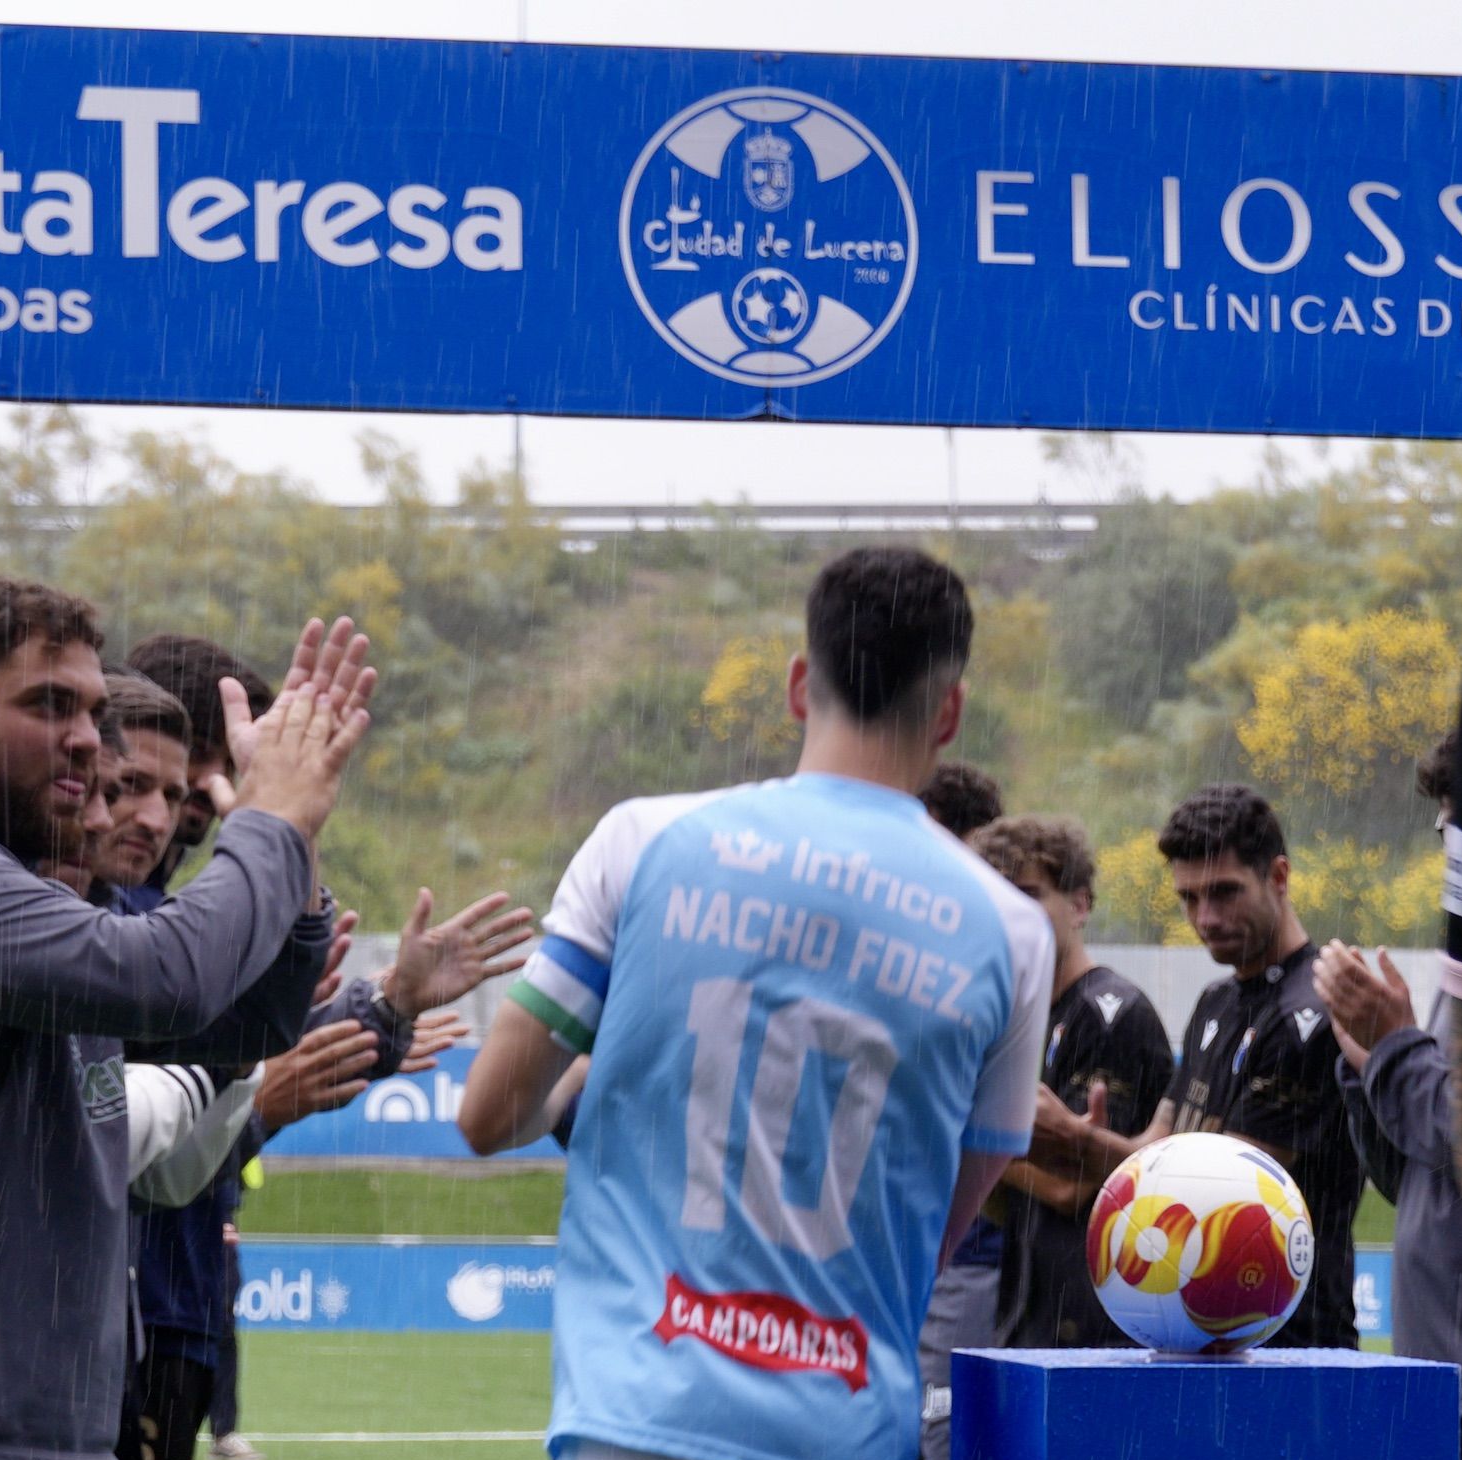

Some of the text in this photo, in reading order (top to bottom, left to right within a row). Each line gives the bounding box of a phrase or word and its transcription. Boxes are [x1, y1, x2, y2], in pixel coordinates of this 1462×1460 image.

[755, 222, 791, 258] de
[803, 219, 905, 262] Lucena
[1128, 283, 1397, 338] CLÍNICAS
[662, 885, 841, 973] NACHO
[791, 837, 963, 936] Infrico
[680, 976, 901, 1261] 10
[670, 1290, 861, 1372] CAMPOARAS
